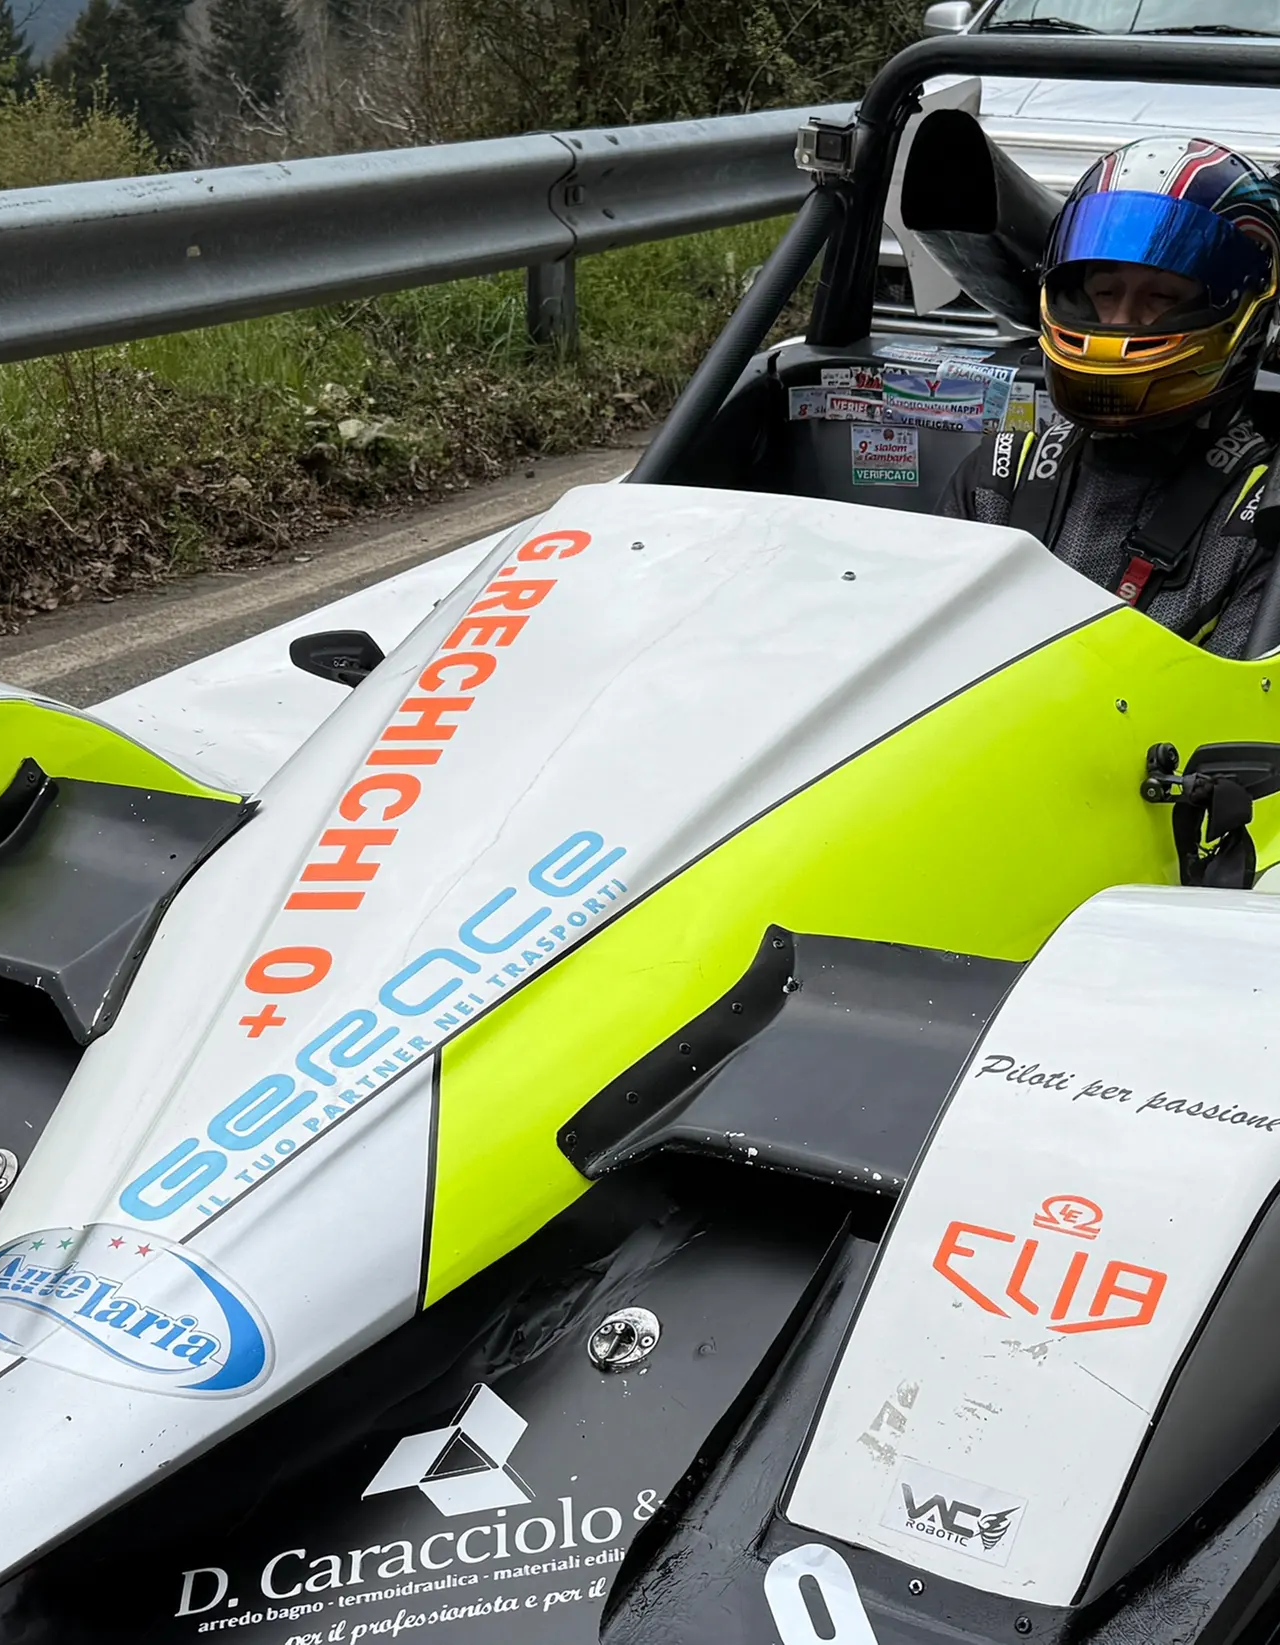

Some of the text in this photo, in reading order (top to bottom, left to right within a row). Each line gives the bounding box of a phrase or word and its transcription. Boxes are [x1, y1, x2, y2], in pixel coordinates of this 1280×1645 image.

[901, 416, 964, 431] VERIFICATO
[950, 404, 980, 415] NAPPI
[856, 469, 915, 481] VERIFICATO
[283, 529, 592, 911] G.RECHICHI
[195, 878, 629, 1218] IL TUO PARTNER NEI TRASPORTI
[975, 1054, 1069, 1092] Piloti
[1073, 1078, 1134, 1104] per
[174, 1488, 665, 1618] D. Caracciolo &
[905, 1518, 970, 1548] ROBOTIC
[198, 1611, 263, 1634] arredo
[265, 1600, 324, 1624] bagno
[338, 1573, 479, 1610] termoidraulica
[493, 1553, 581, 1582] materiali
[584, 1547, 625, 1569] edili
[284, 1577, 607, 1645] per il professionista e per il
